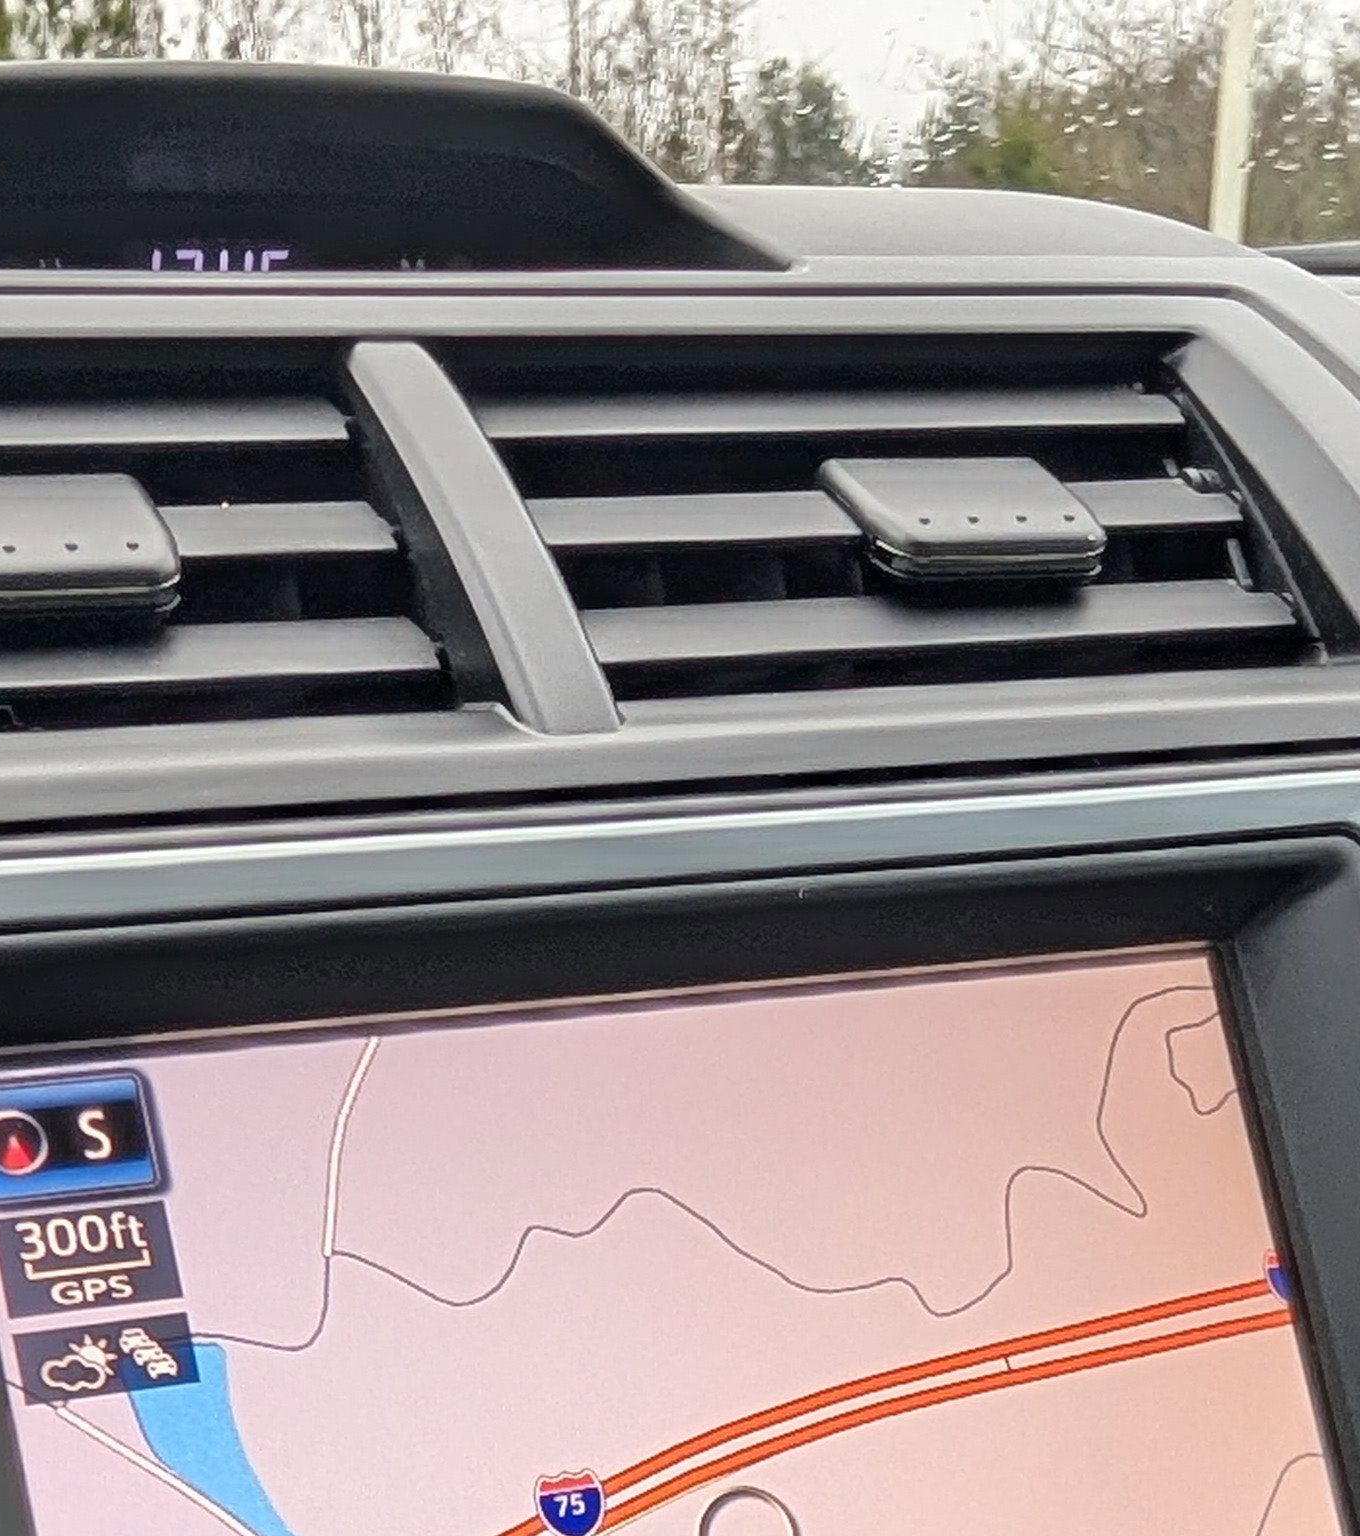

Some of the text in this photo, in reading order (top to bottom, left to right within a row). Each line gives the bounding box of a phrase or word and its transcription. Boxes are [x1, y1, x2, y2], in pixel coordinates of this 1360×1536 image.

[77, 1109, 112, 1160] S
[14, 1211, 148, 1261] 300ft
[50, 1274, 134, 1305] GPS
[553, 1493, 586, 1518] 75
